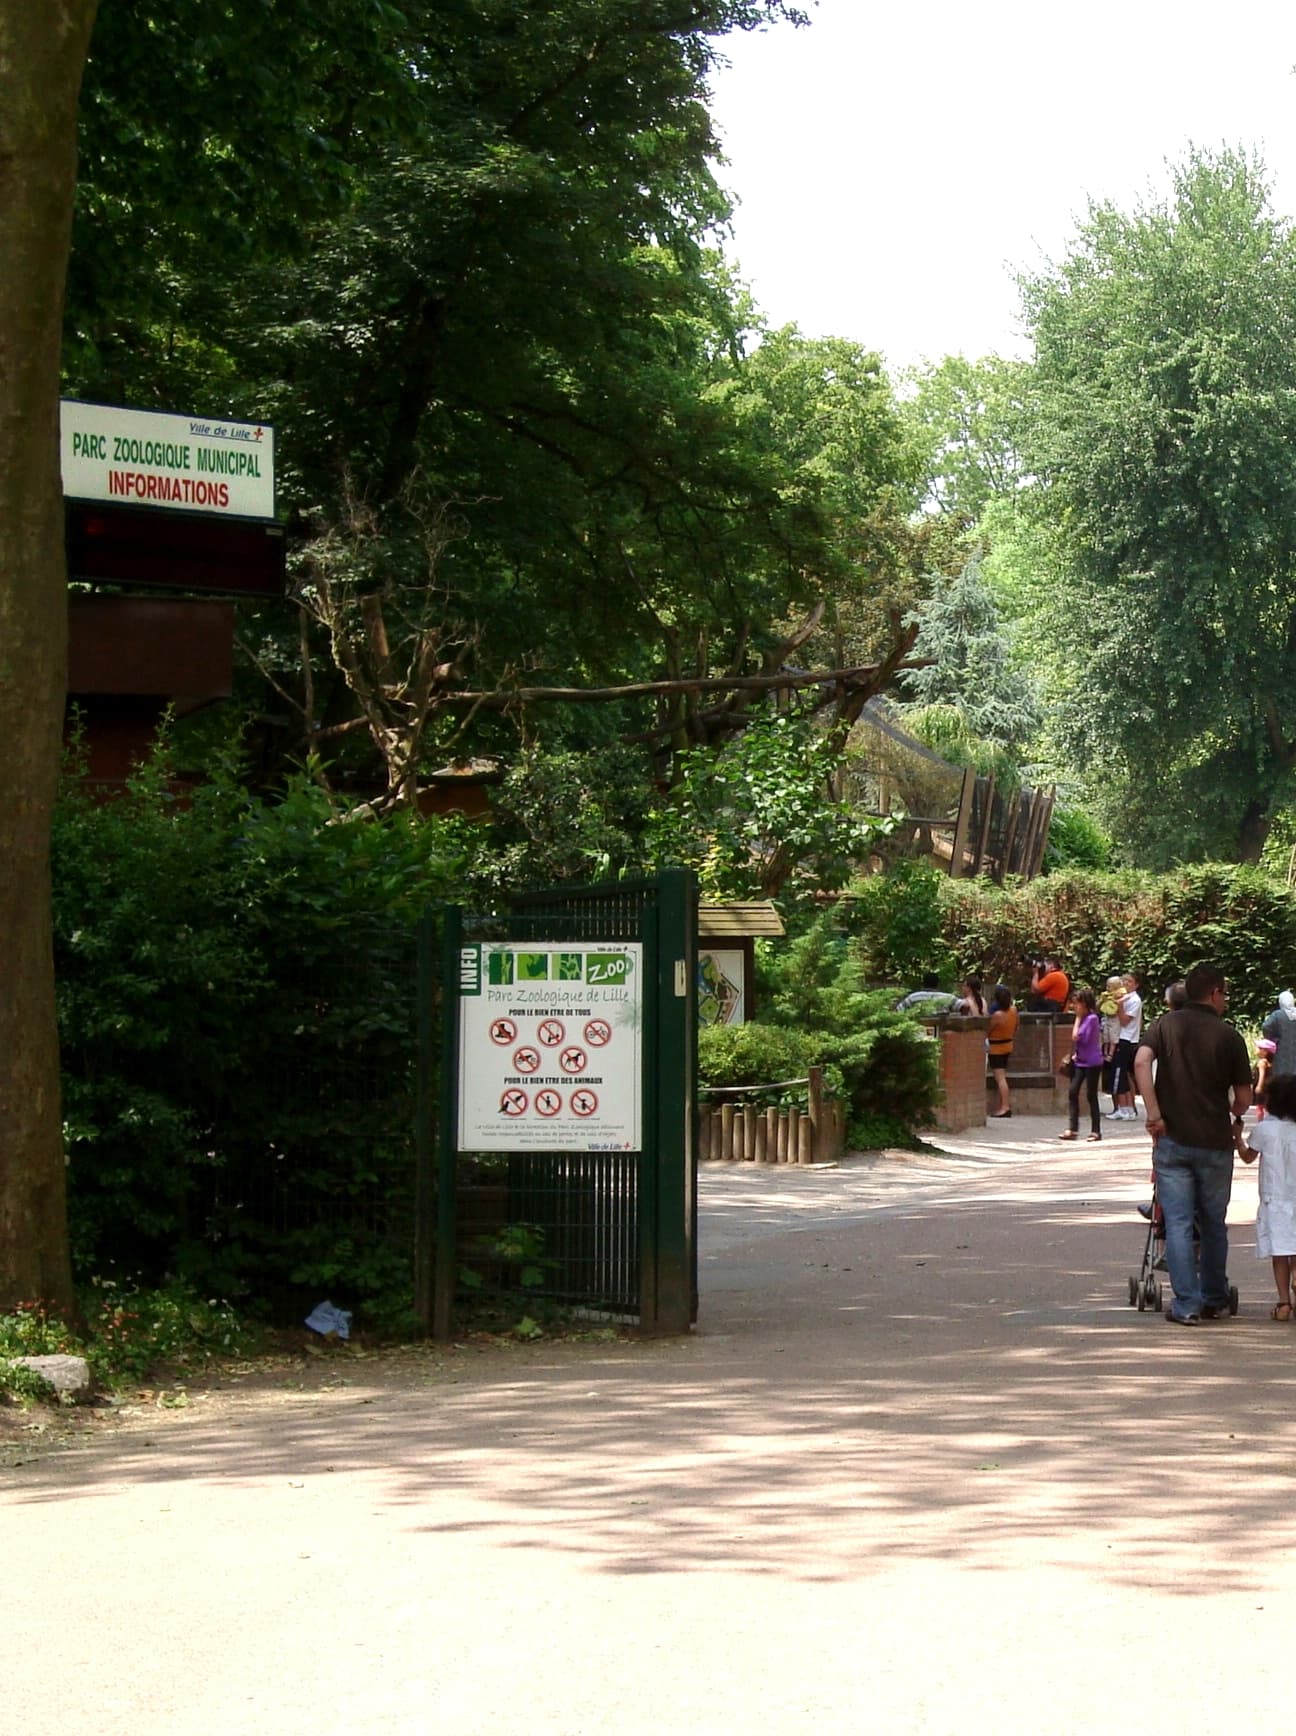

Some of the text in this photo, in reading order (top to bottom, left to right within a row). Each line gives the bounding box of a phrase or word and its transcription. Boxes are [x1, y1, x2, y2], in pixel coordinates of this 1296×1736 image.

[190, 422, 250, 439] Ville de Lille
[73, 432, 261, 478] PARC ZOOLOGIQUE MUNICIPAL
[109, 470, 229, 507] INFORMATIONS
[460, 948, 478, 990] INFO
[487, 988, 629, 1006] Parc Zoologique de Lille
[504, 1077, 521, 1085] POUR
[521, 1077, 528, 1085] LE
[529, 1077, 544, 1085] BIEN
[574, 1077, 602, 1085] ANIMAUX
